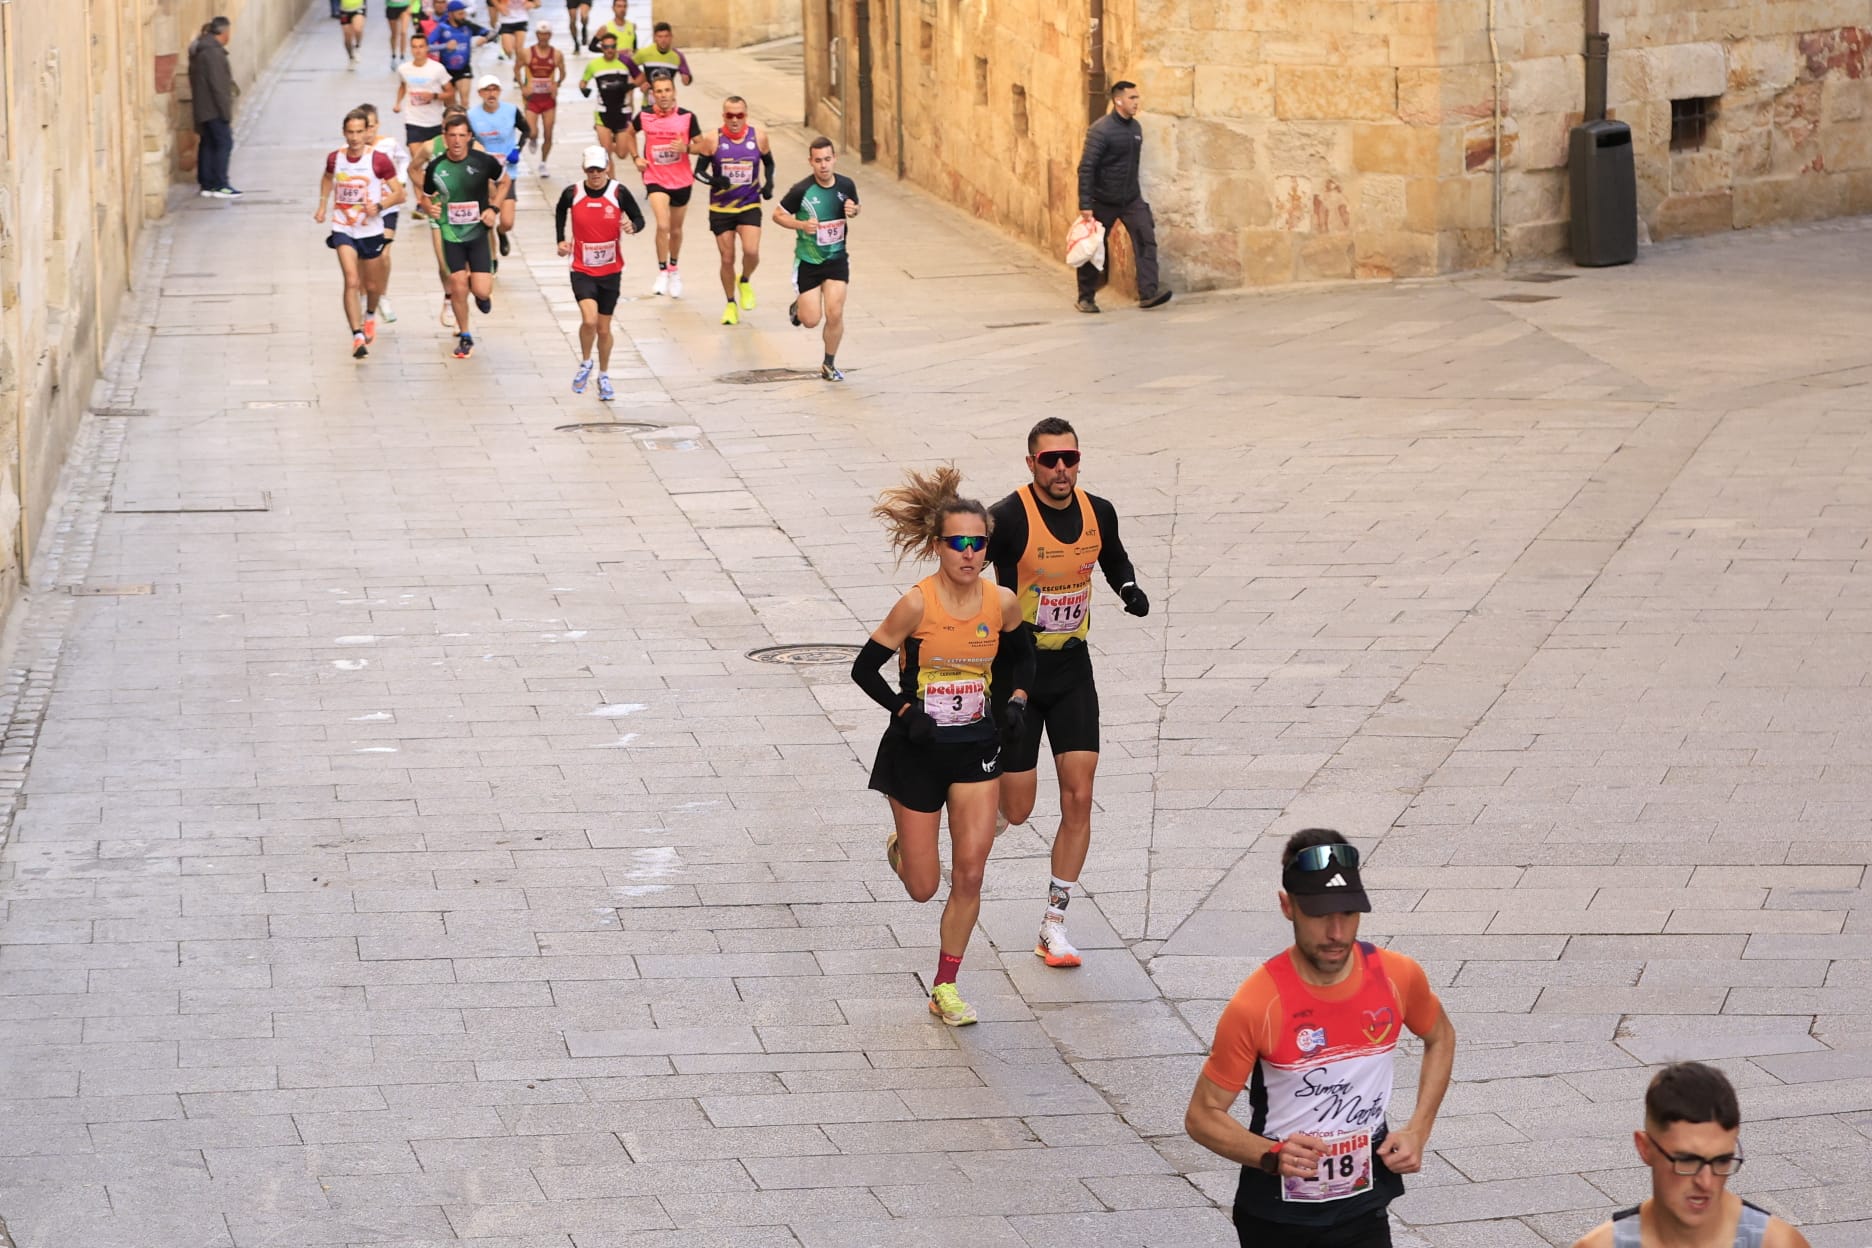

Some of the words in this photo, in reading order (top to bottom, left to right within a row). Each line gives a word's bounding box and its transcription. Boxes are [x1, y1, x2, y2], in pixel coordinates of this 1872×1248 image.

[827, 227, 838, 237] 95
[593, 250, 607, 259] 37
[1051, 604, 1081, 621] 116
[951, 695, 963, 711] 3
[1318, 1134, 1369, 1158] unia
[1303, 1155, 1354, 1182] 18
